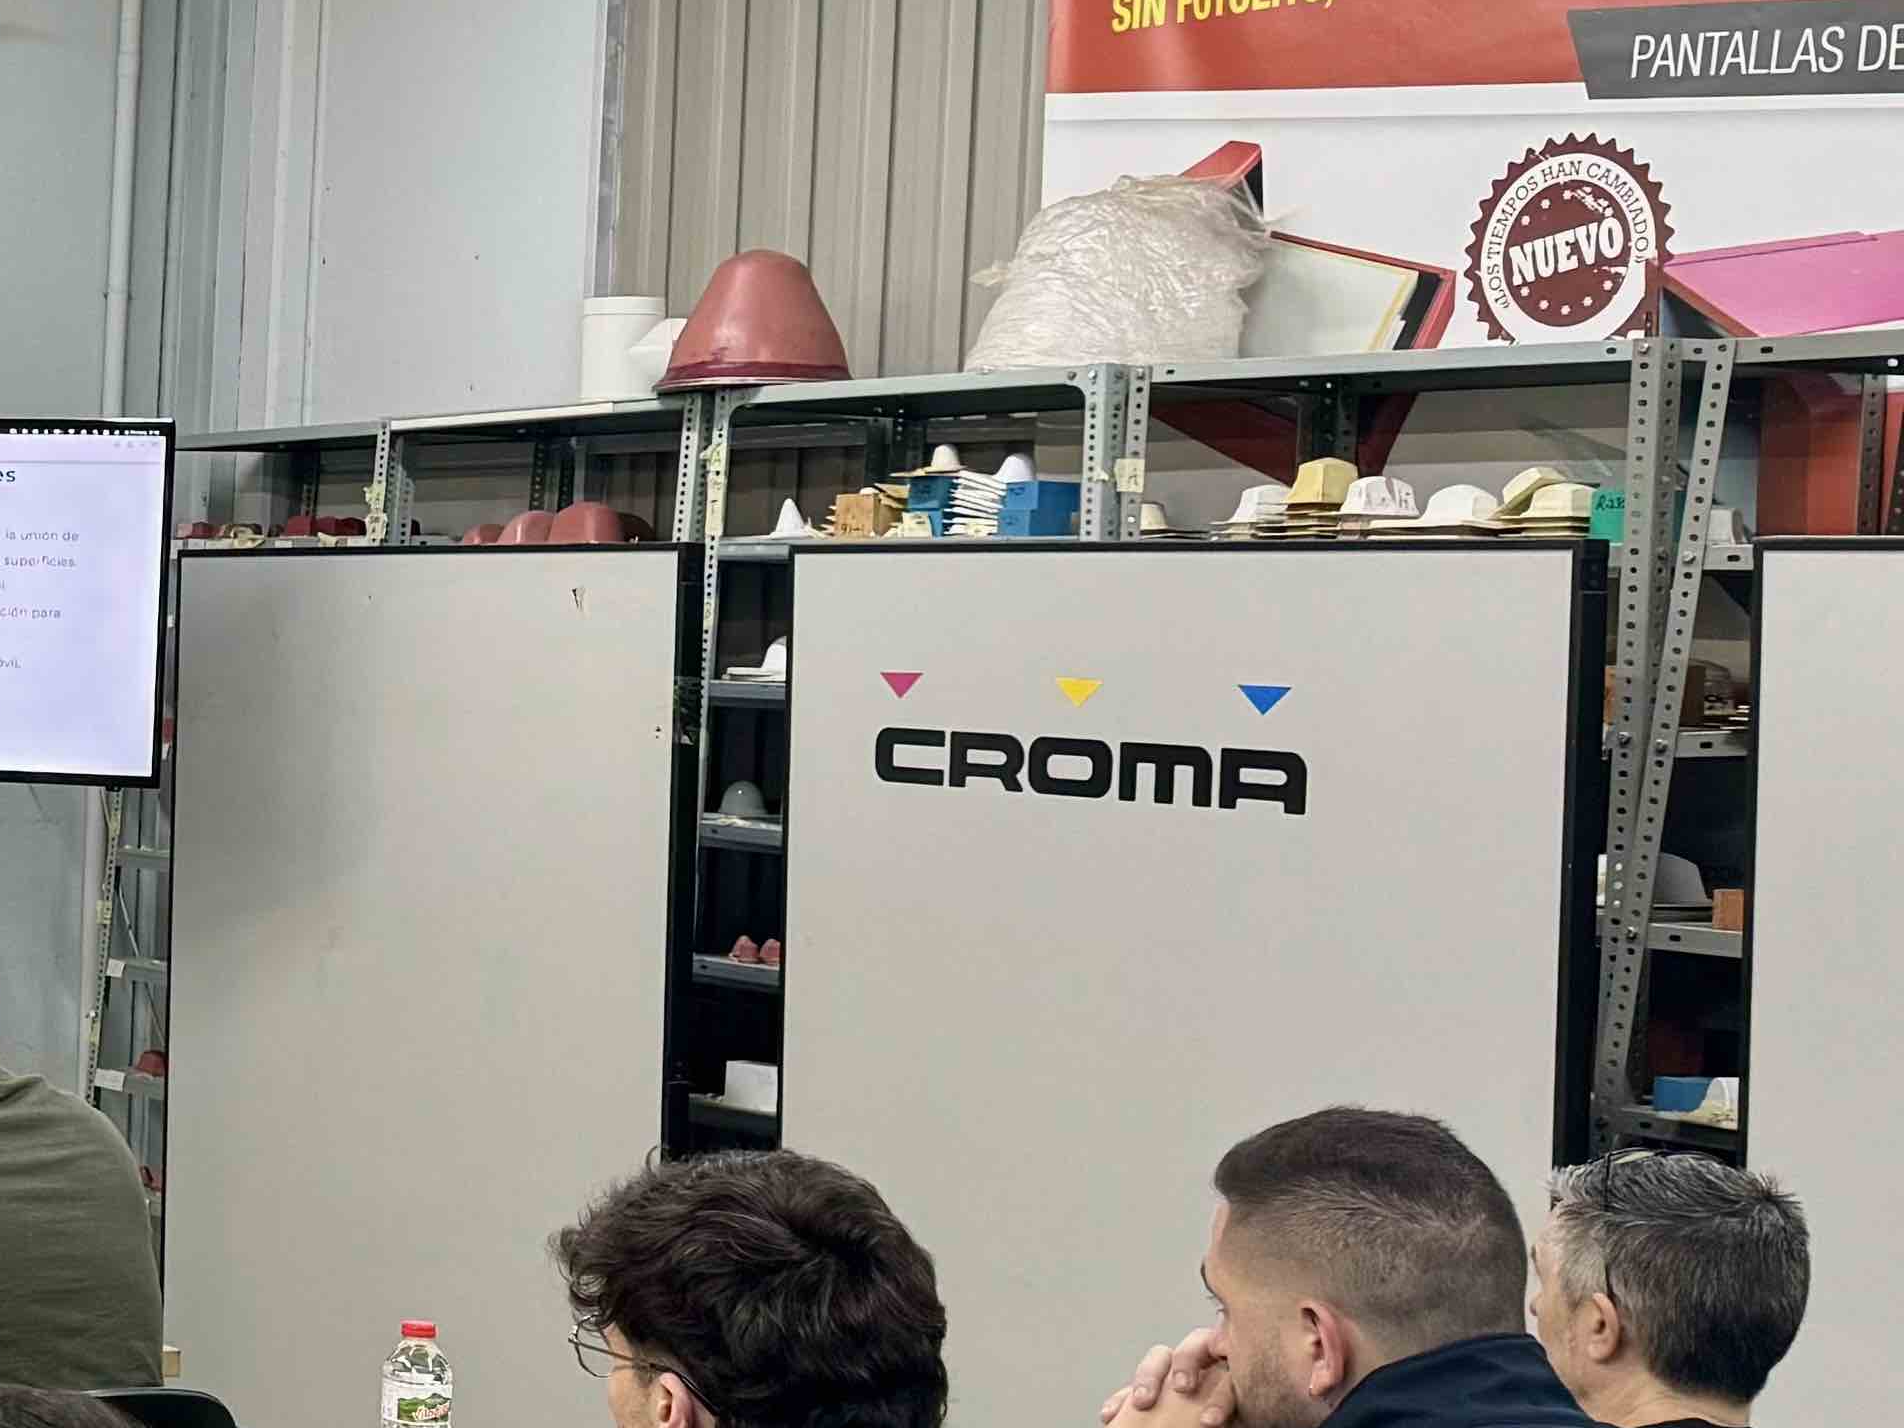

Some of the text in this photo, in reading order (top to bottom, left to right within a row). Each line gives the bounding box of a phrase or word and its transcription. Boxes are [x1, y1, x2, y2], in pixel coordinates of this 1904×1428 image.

[1630, 26, 1846, 79] PANTALLAS
[1487, 175, 1539, 260] TIEMPOS
[1542, 160, 1582, 182] HAN
[1508, 216, 1625, 287] NUEVO
[875, 726, 1309, 816] CROMA
